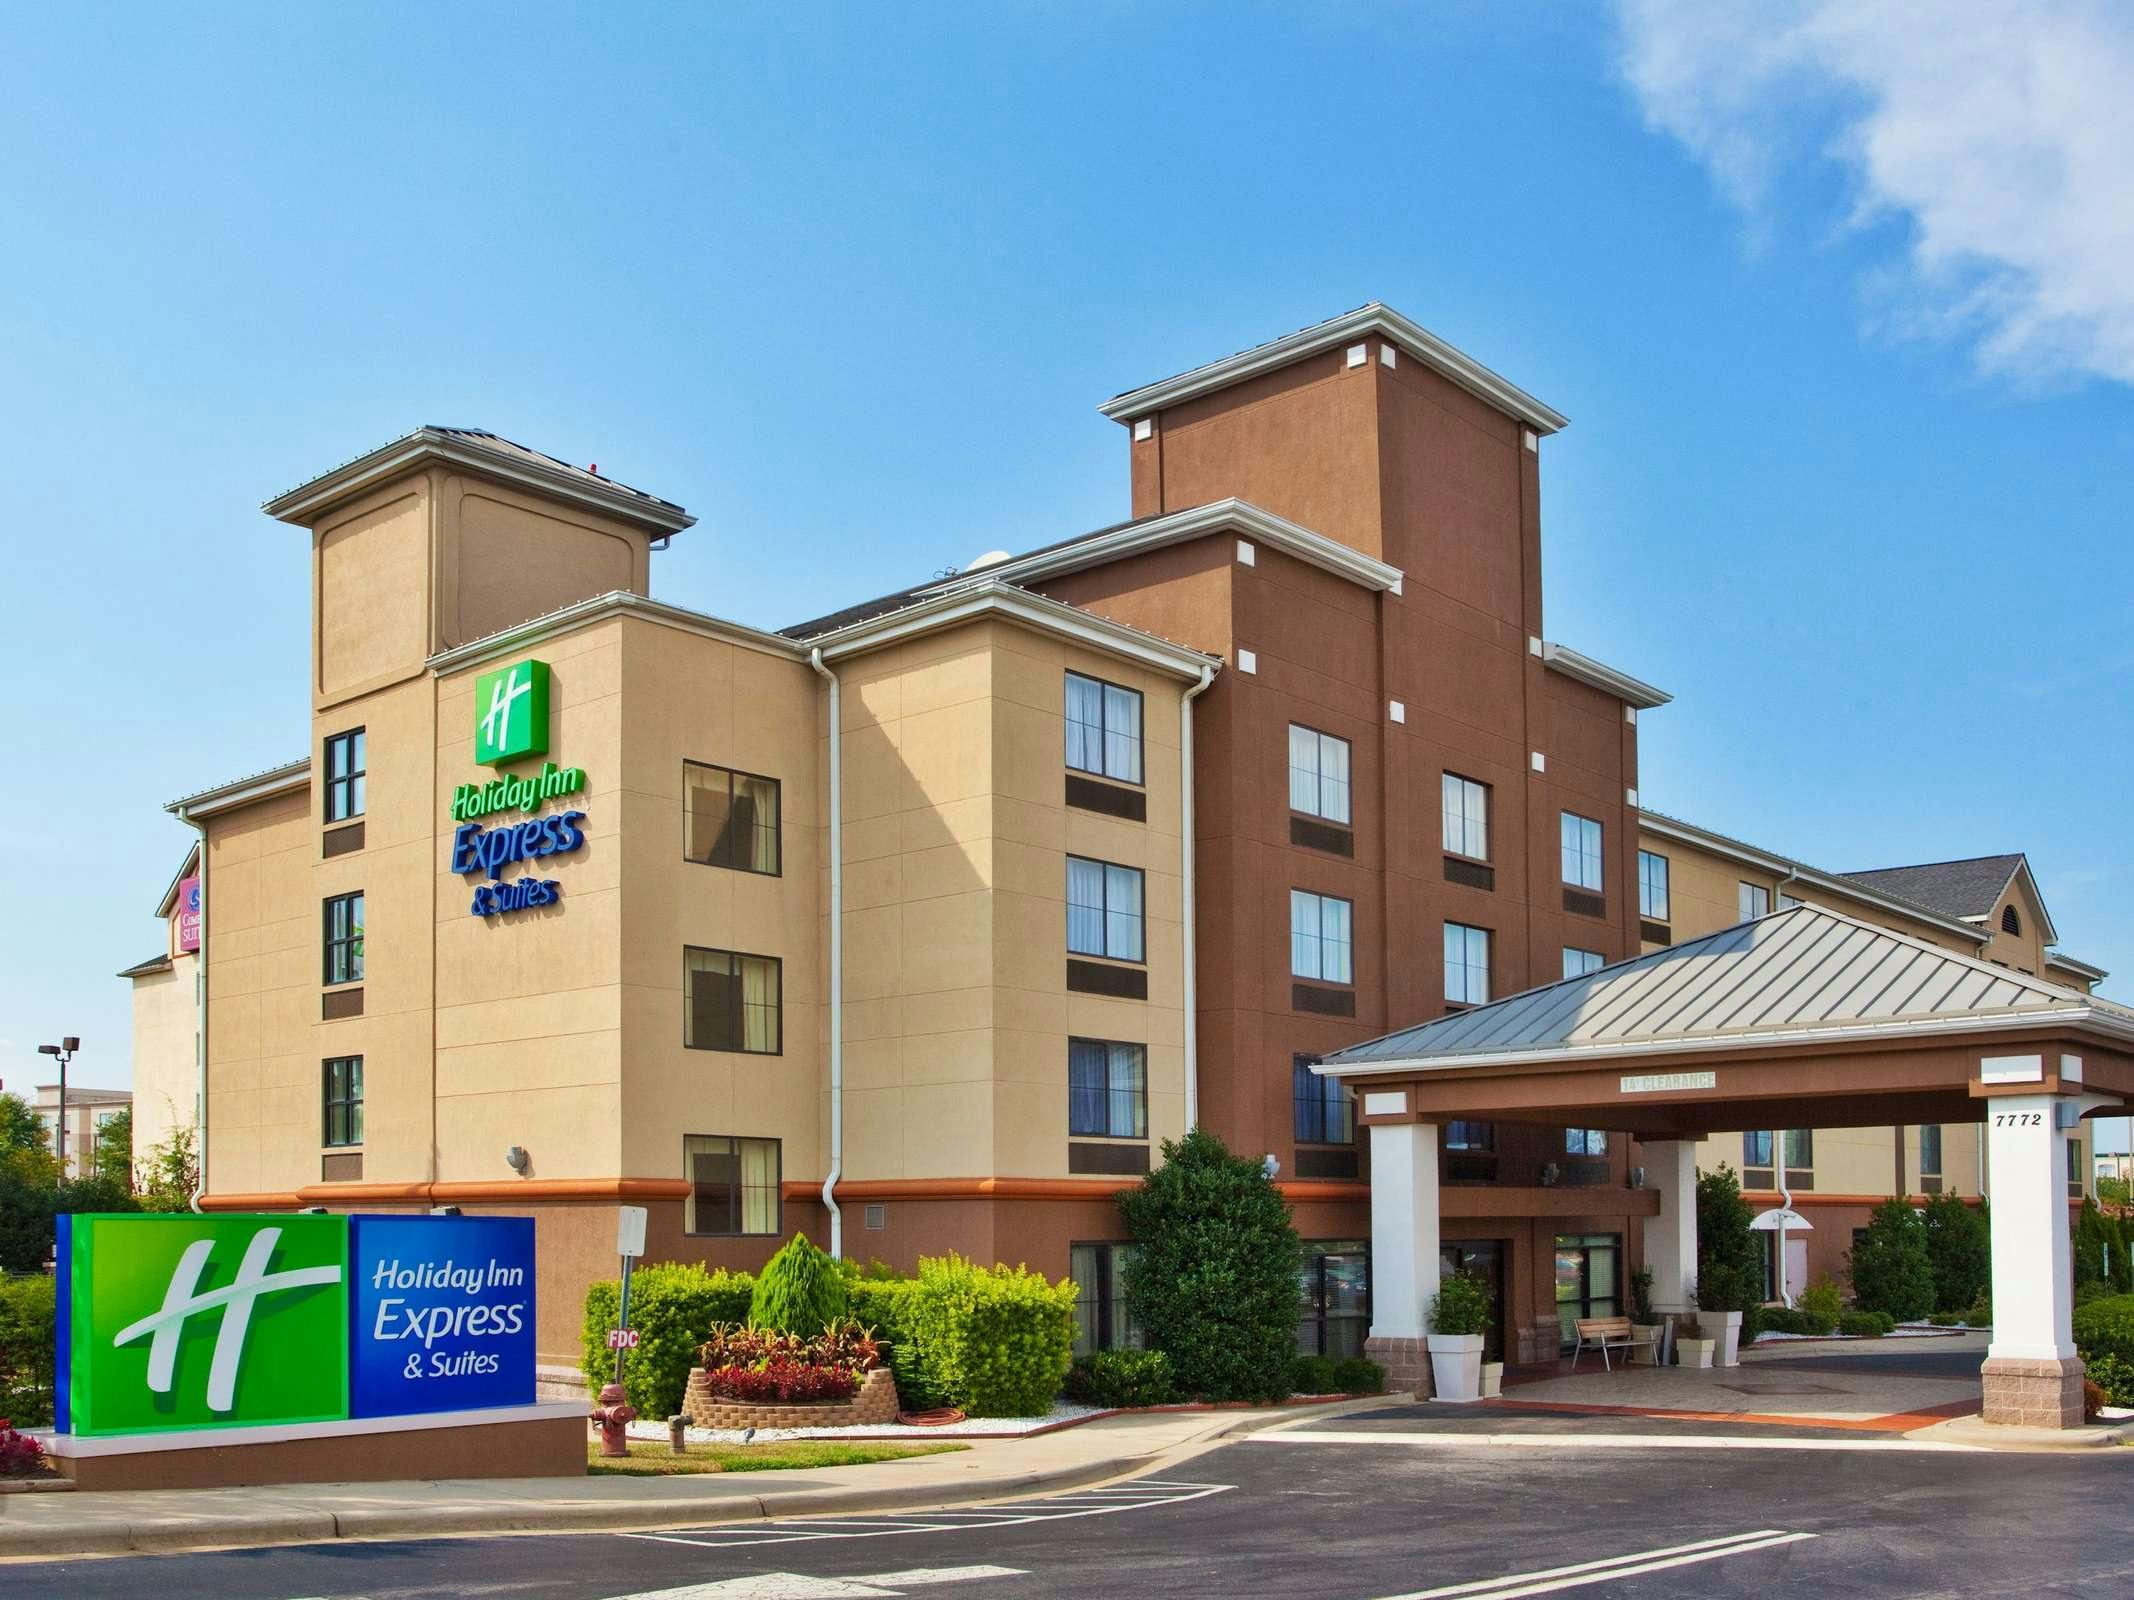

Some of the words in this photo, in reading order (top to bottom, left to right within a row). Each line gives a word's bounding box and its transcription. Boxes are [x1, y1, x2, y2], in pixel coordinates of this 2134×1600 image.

[480, 668, 532, 752] H
[452, 773, 541, 821] Holiday
[540, 762, 583, 798] Inn
[452, 810, 586, 880] Express
[471, 886, 494, 916] &
[491, 877, 560, 914] Suites
[1643, 1072, 1715, 1090] CLEARANCE
[1996, 1113, 2041, 1127] 7772
[372, 1259, 484, 1295] Holiday
[486, 1258, 524, 1287] Inn
[113, 1226, 342, 1412] H
[373, 1298, 524, 1350] Express
[608, 1330, 640, 1349] FDC
[403, 1352, 424, 1379] &
[428, 1350, 500, 1377] Suites
